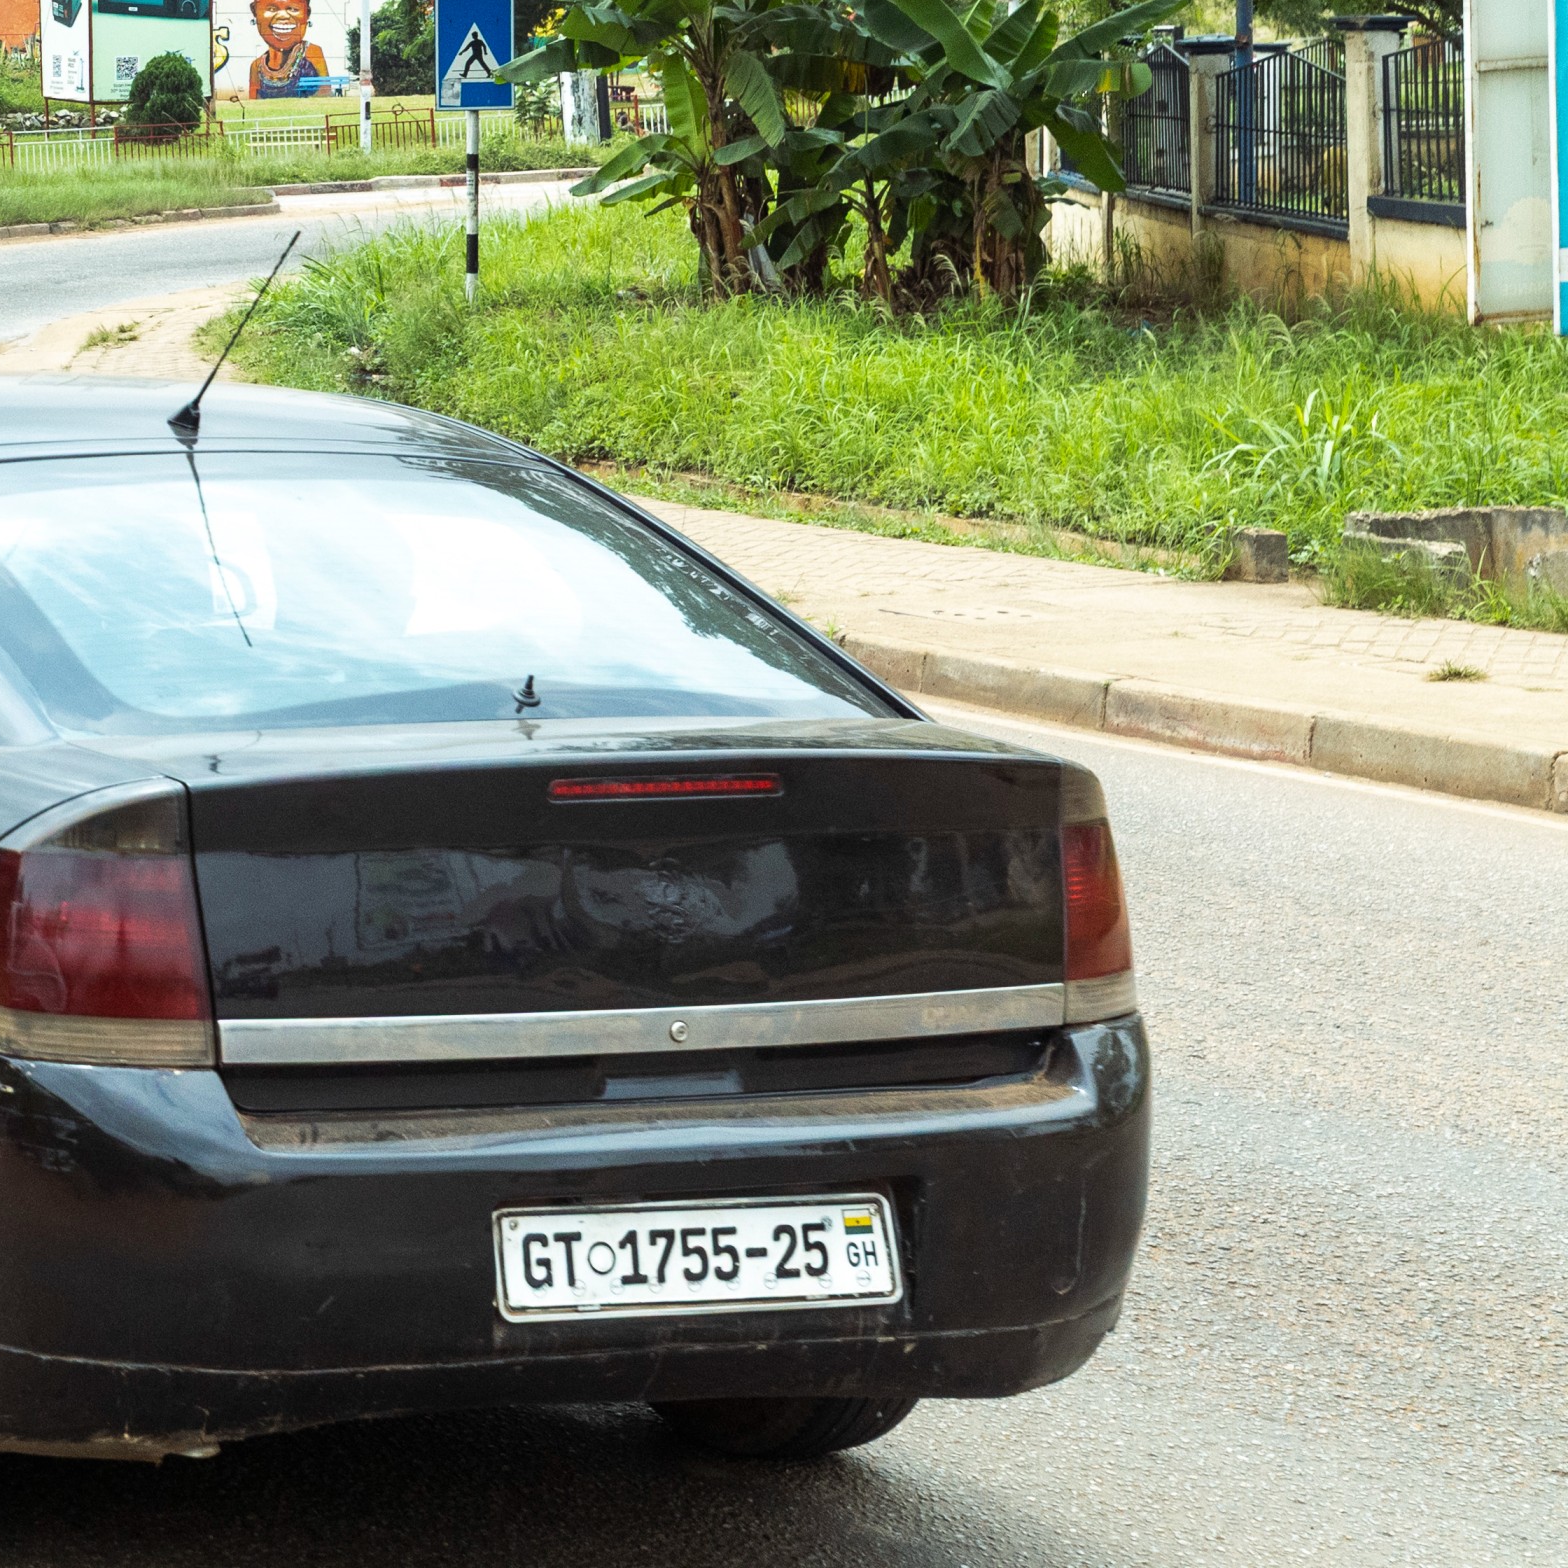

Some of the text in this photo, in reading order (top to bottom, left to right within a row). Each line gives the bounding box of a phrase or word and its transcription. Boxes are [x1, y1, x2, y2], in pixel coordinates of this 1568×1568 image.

[522, 1222, 830, 1289] GT 1755-25
[846, 1240, 879, 1268] GH
